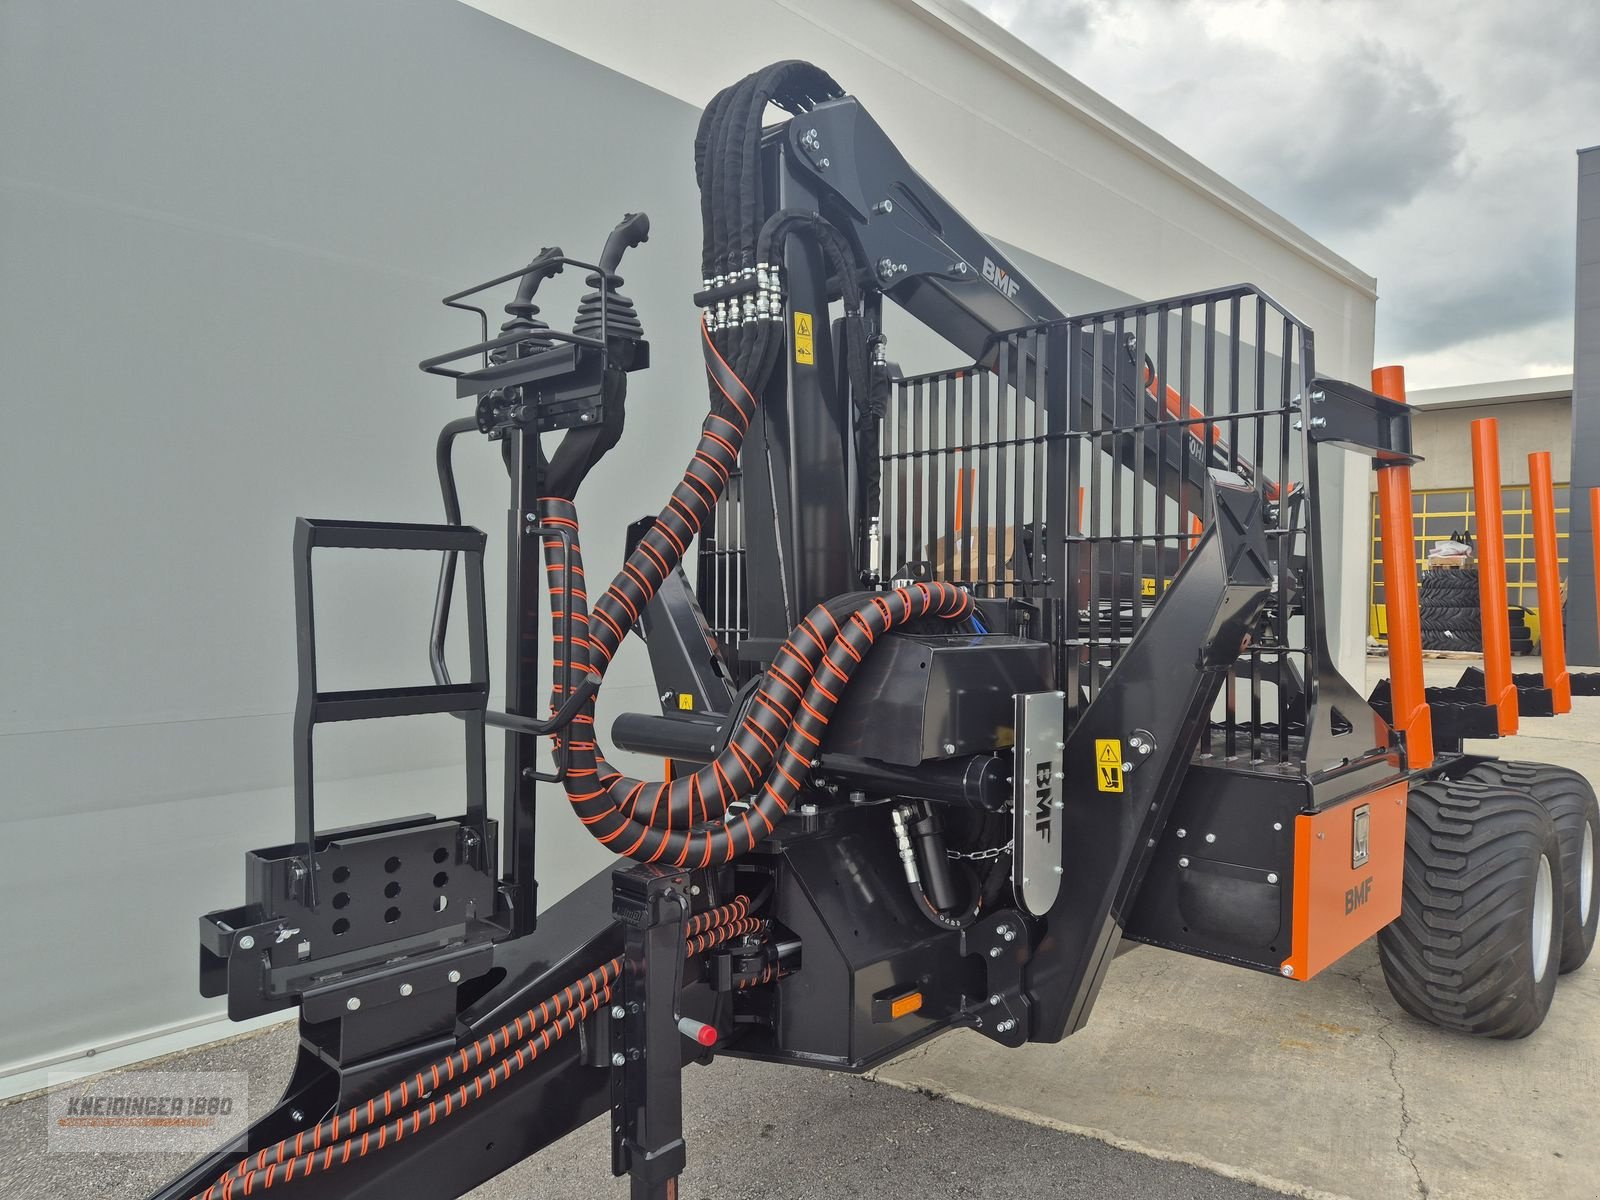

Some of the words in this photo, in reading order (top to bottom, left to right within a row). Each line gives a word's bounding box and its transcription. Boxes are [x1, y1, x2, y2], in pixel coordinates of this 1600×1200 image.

[982, 255, 1020, 298] BMF
[1035, 761, 1053, 844] BMF
[1344, 876, 1374, 916] BMF
